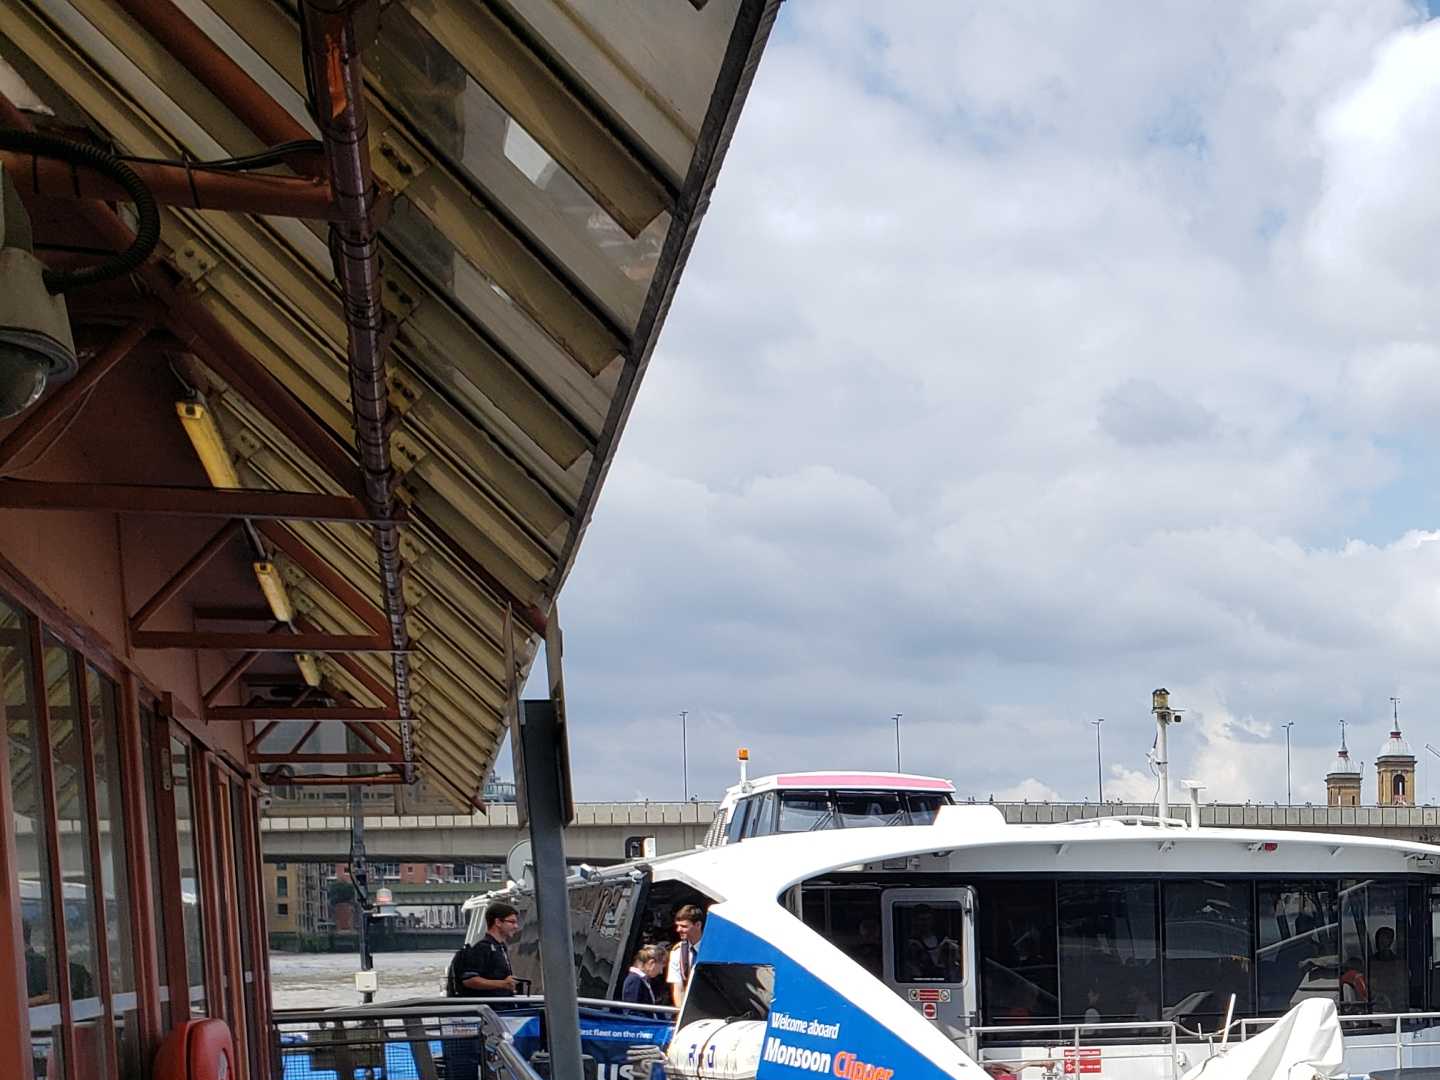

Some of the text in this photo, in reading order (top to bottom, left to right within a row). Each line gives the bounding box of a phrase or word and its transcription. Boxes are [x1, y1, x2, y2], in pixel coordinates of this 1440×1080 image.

[580, 1028, 593, 1036] est
[593, 1028, 612, 1037] fleet
[623, 1030, 636, 1038] the
[636, 1030, 654, 1039] river
[771, 1012, 840, 1040] Welcome aboard
[763, 1037, 832, 1074] Monsoon
